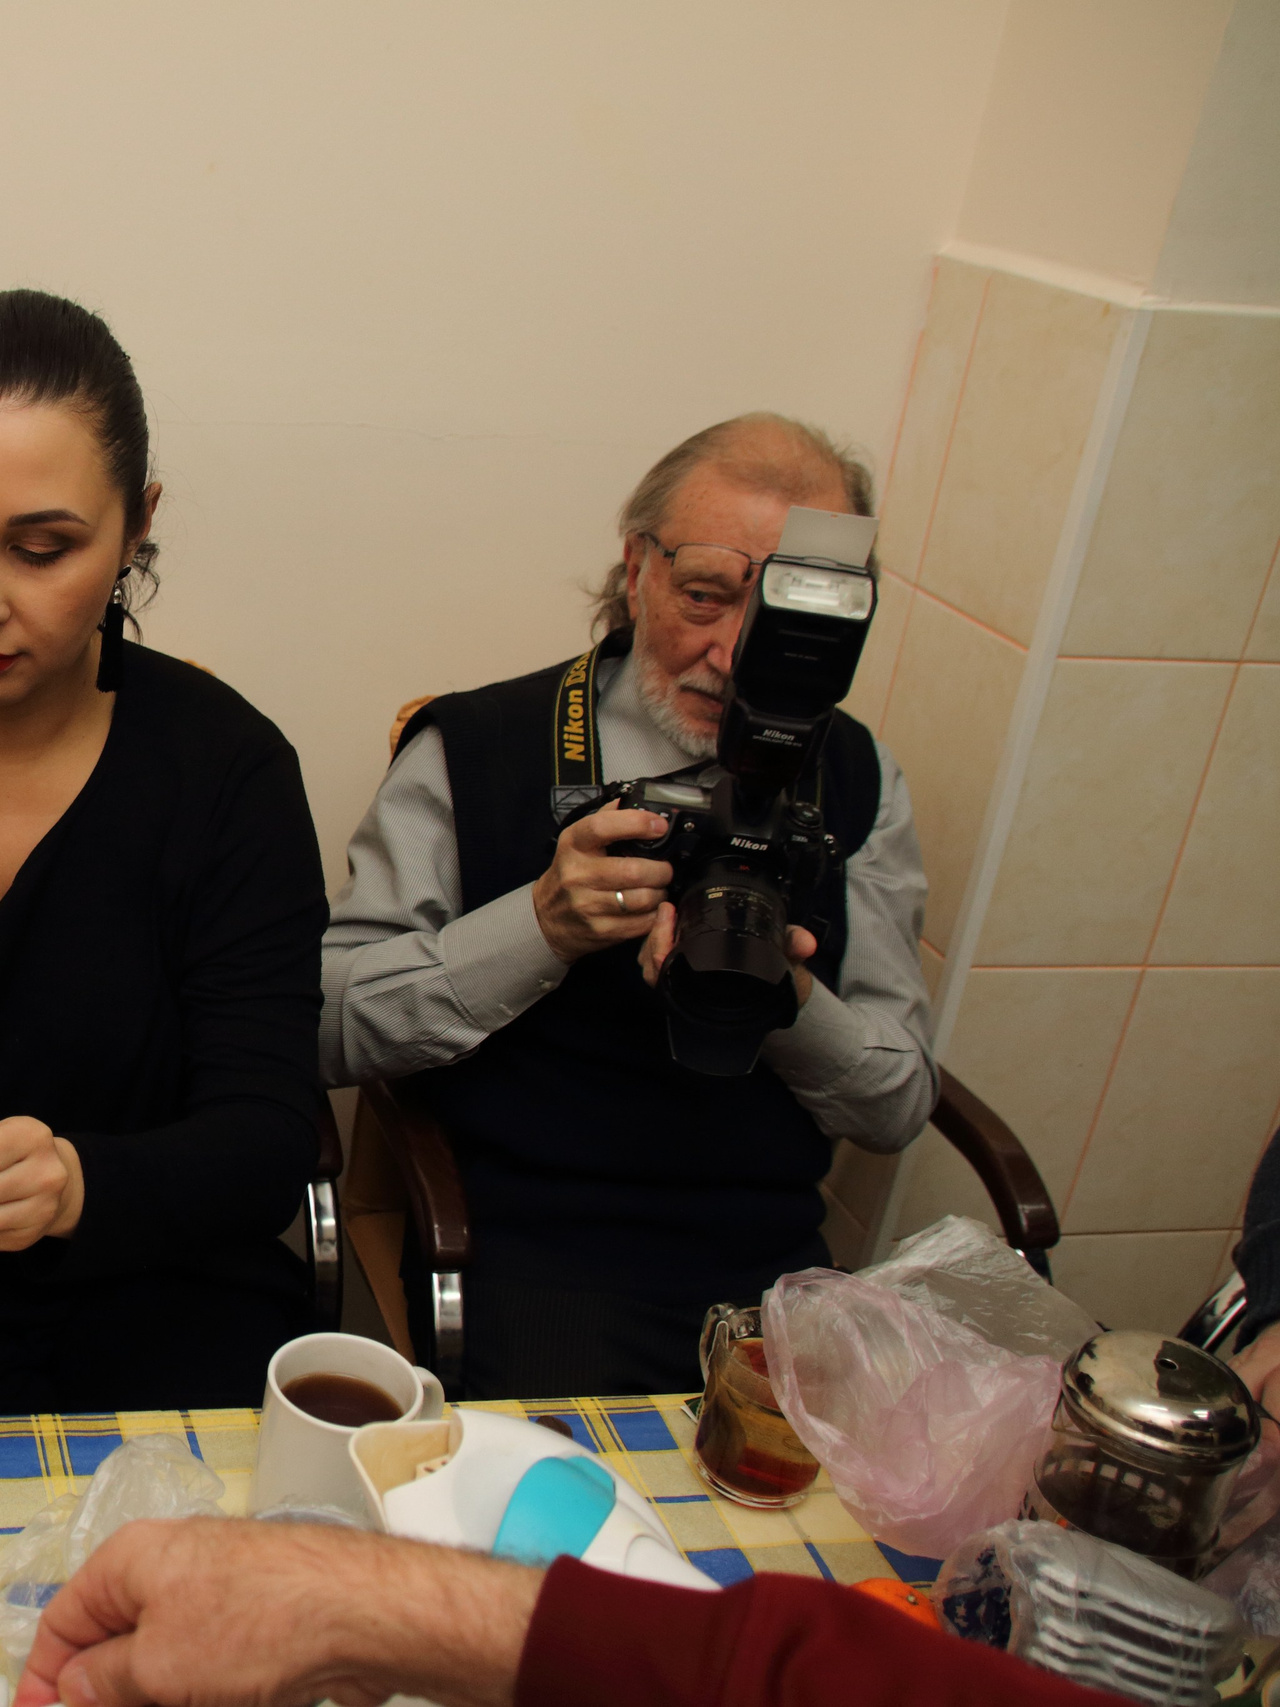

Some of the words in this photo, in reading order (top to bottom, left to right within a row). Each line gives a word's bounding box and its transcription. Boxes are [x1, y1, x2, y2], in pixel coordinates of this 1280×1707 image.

[563, 689, 586, 762] Nikon
[762, 728, 796, 741] Nikon
[730, 836, 769, 851] Nikon
